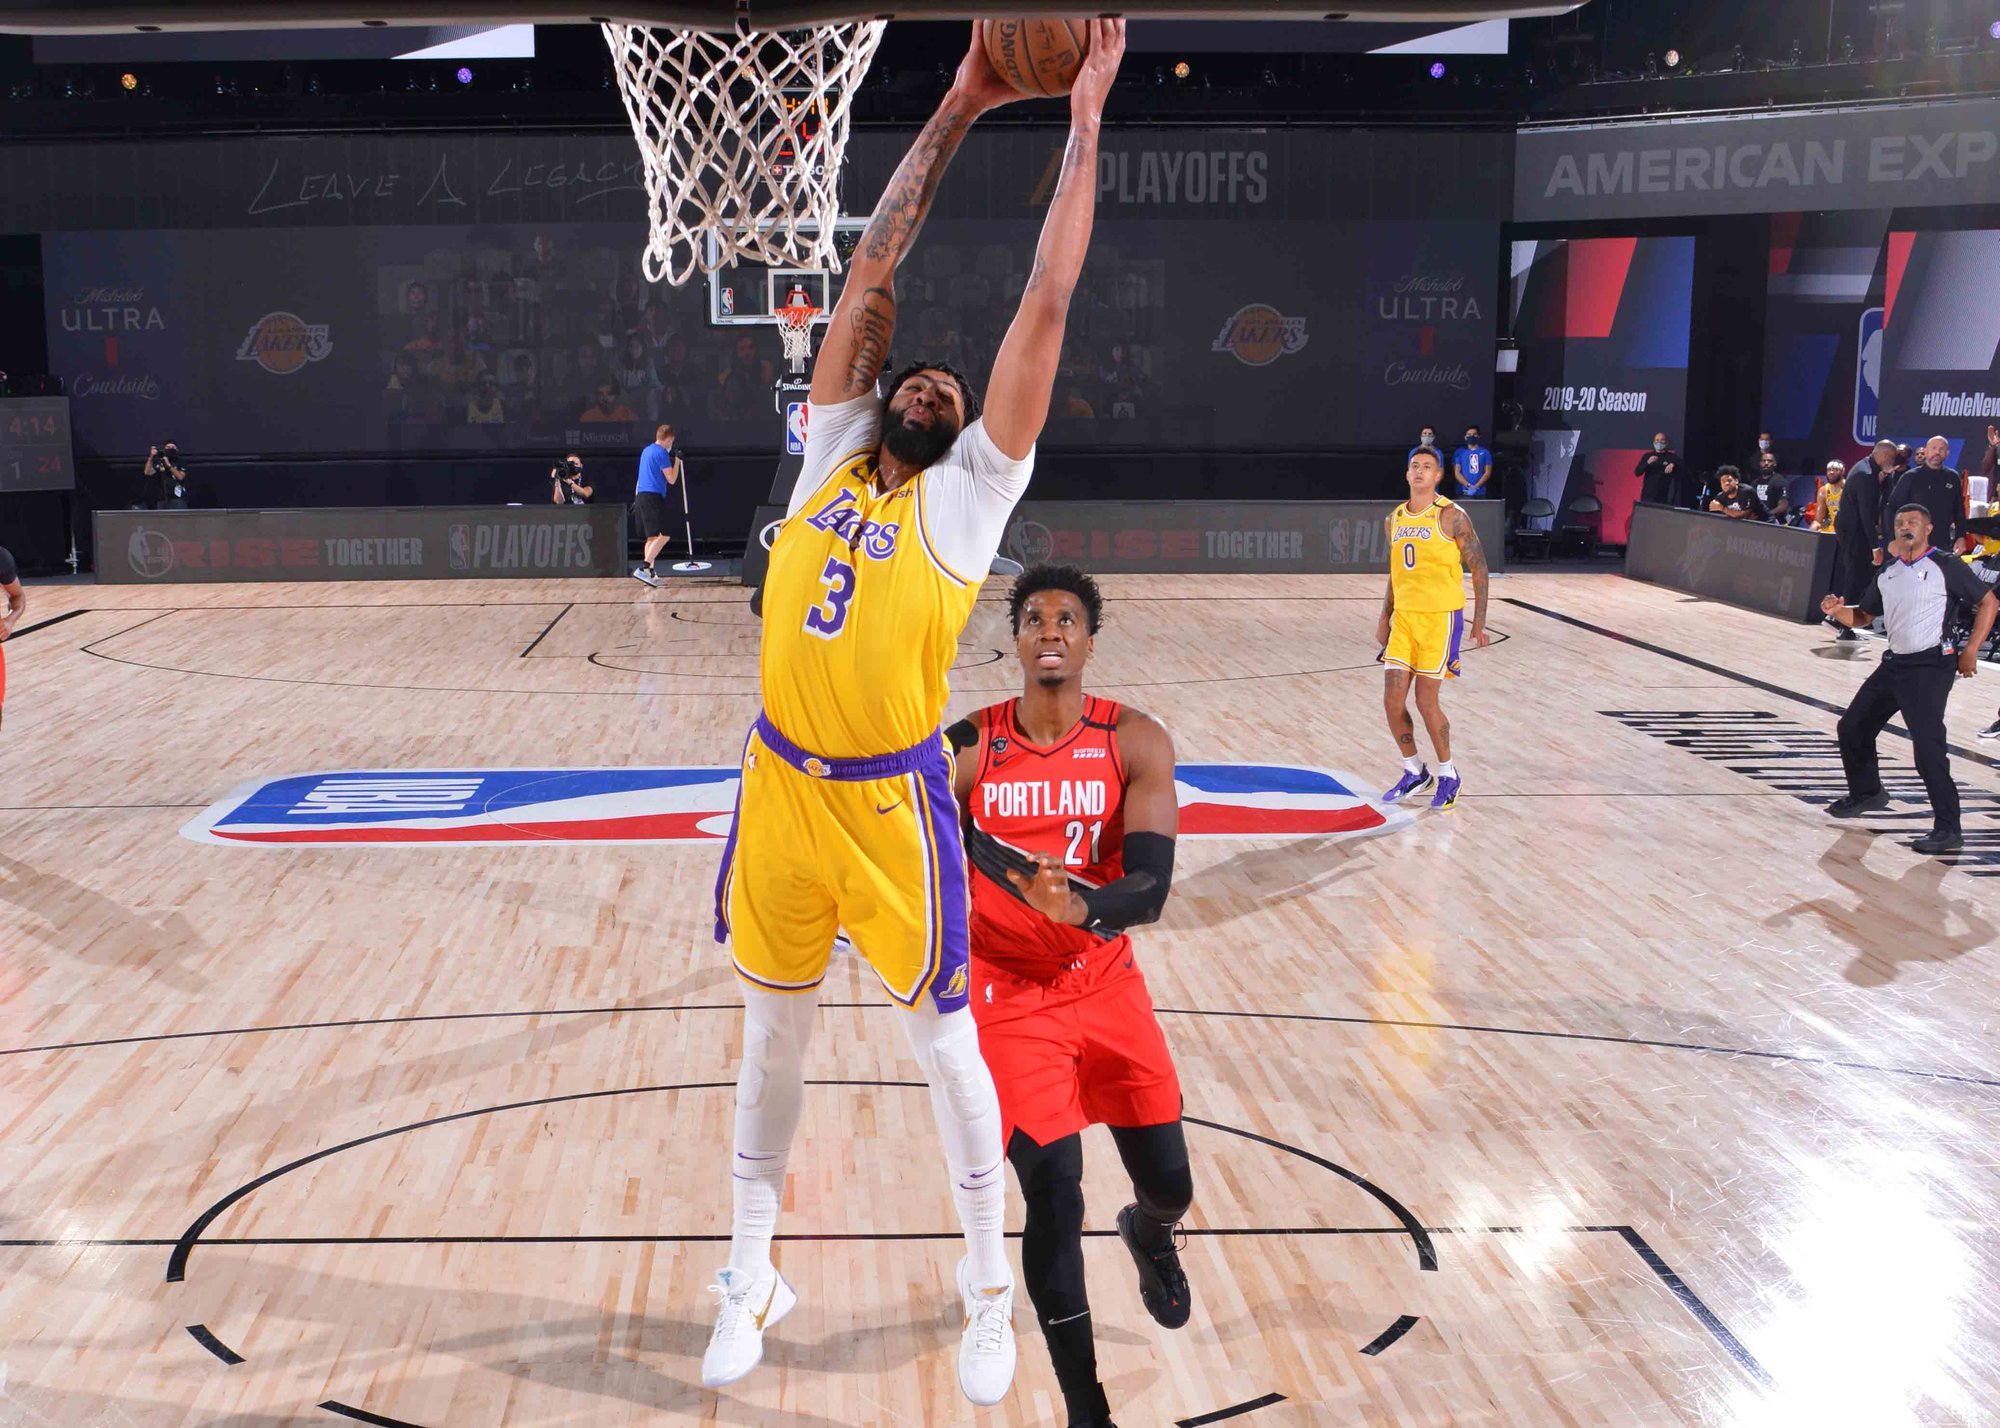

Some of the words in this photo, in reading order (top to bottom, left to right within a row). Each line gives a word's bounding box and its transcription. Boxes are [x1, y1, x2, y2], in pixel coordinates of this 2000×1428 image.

[1096, 151, 1268, 204] PLAYOFFS
[1543, 139, 1846, 197] AMERICAN
[1869, 130, 1998, 183] EXP
[248, 158, 401, 214] LEAVE
[417, 153, 467, 206] A
[61, 307, 165, 331] ULTRA
[1379, 297, 1481, 320] ULTRA
[73, 373, 160, 400] Courtside
[1384, 361, 1471, 390] Courtside
[1542, 386, 1597, 411] 2019-20
[1597, 387, 1648, 412] Season
[583, 431, 629, 442] Microsoft
[472, 523, 594, 569] PLAYOFFS
[1051, 530, 1201, 560] RISE
[1204, 530, 1303, 560] TOGETHER
[1393, 526, 1432, 542] LAKERS
[173, 538, 319, 569] RISE
[324, 537, 424, 568] TOGETHER
[1404, 543, 1415, 568] 0
[803, 555, 856, 641] 3
[286, 778, 485, 815] NBA
[981, 780, 1106, 818] PORTLAND
[1064, 820, 1103, 866] 21
